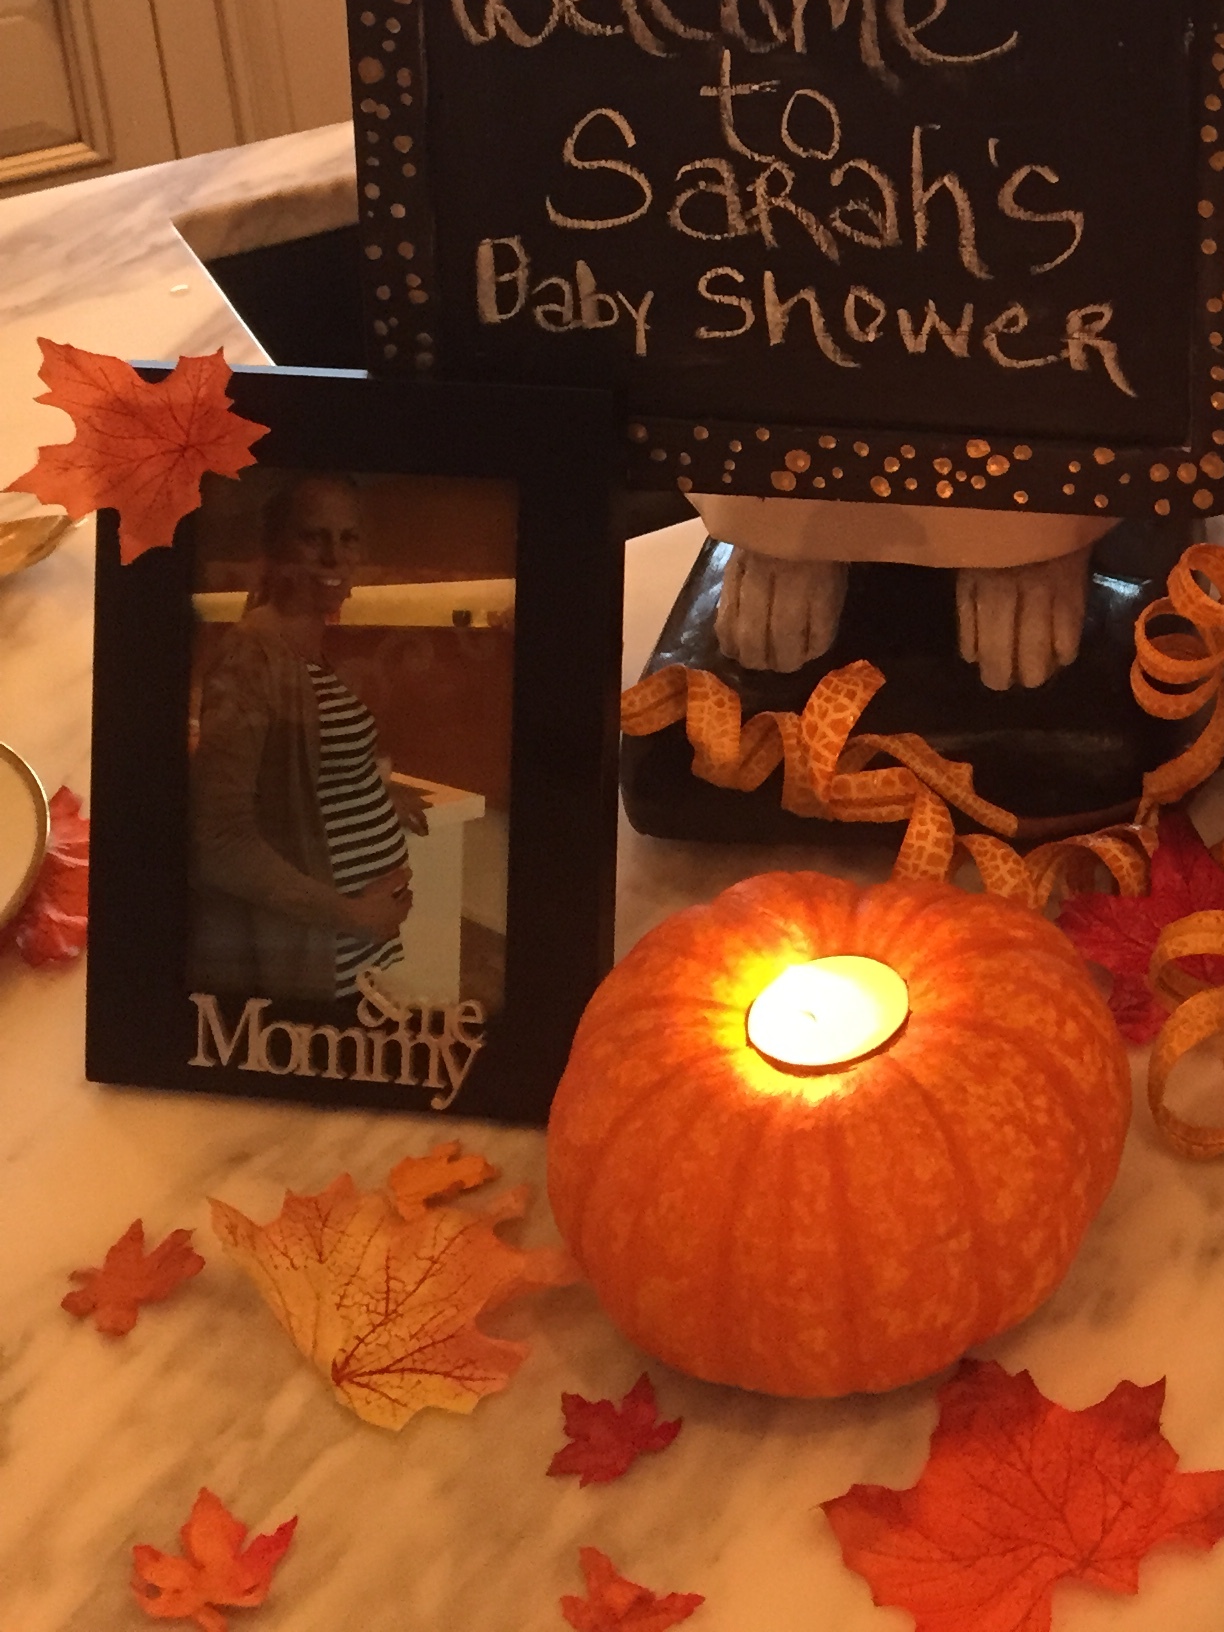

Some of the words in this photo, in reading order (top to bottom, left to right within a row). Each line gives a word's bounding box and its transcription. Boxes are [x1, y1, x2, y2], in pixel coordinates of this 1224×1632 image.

[700, 49, 842, 162] to
[476, 234, 655, 356] Baby
[187, 993, 486, 1110] Mommy
